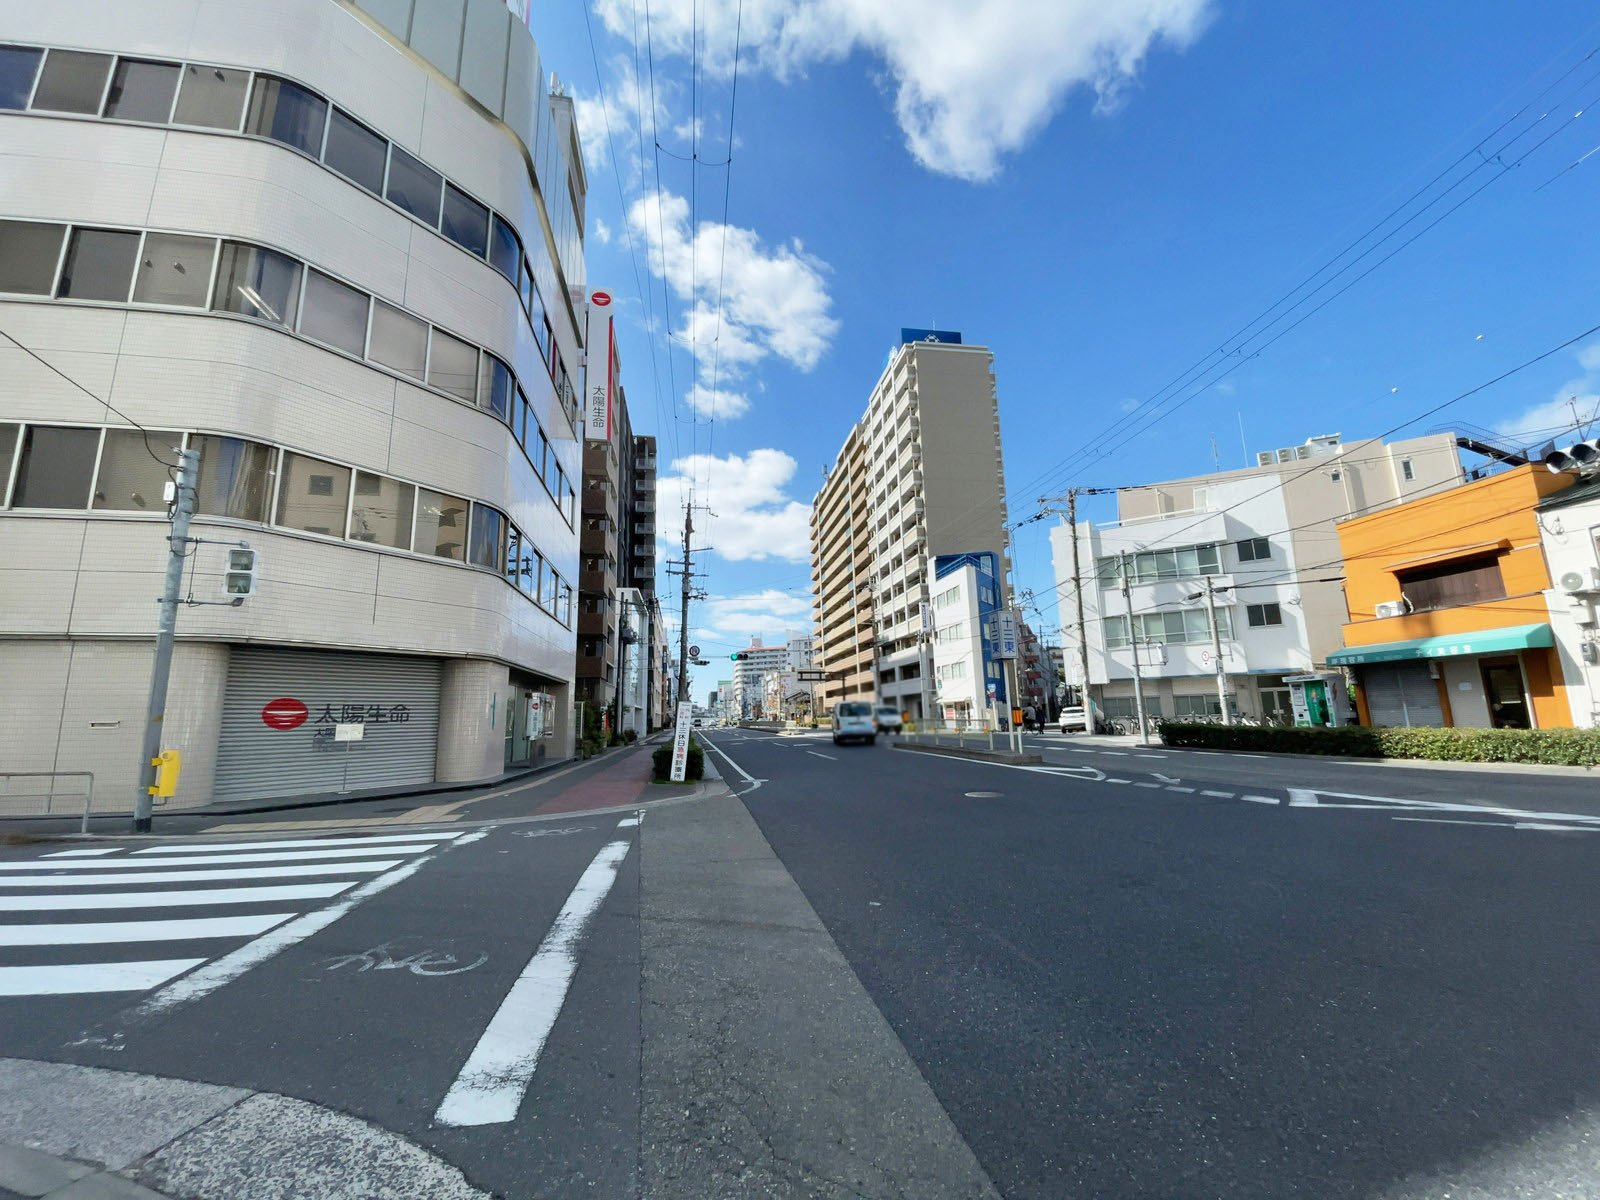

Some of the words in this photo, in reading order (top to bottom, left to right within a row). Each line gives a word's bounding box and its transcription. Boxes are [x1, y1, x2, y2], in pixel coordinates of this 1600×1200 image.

[592, 385, 606, 428] 太陽生命
[991, 617, 1000, 654] 十三東
[1002, 616, 1015, 653] 十三東
[314, 703, 411, 724] 太陽生命
